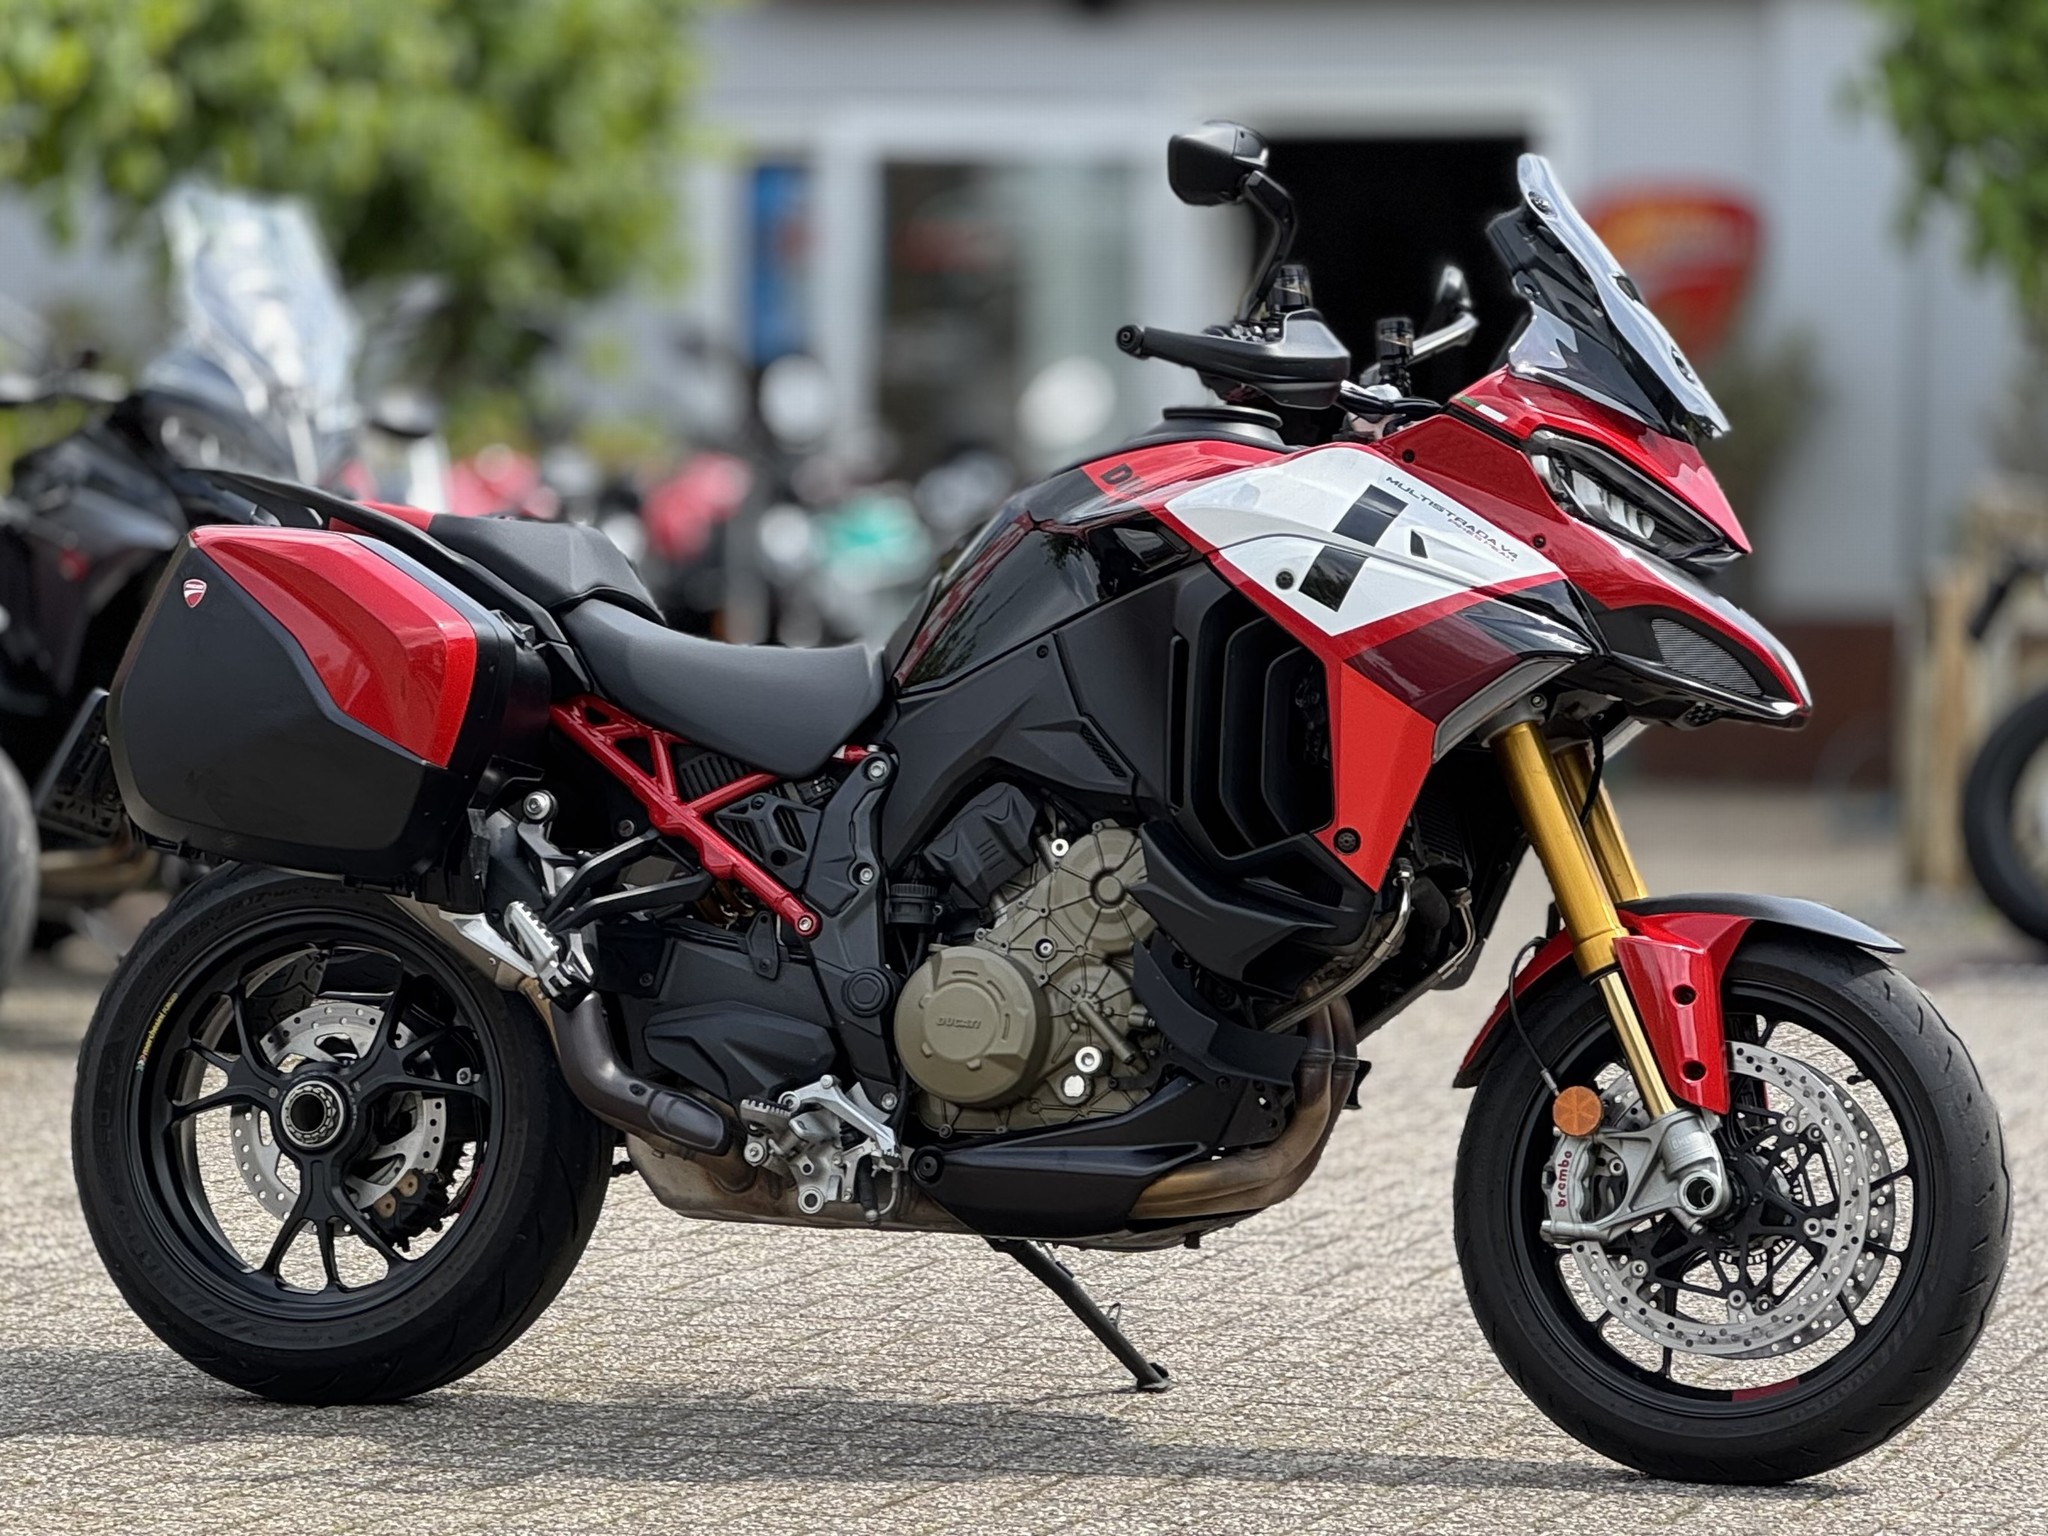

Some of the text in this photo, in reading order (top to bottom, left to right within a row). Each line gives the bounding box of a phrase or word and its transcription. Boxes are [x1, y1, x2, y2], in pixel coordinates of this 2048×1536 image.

[1386, 477, 1518, 559] MULTISTRADA V4
[936, 1017, 982, 1030] DUCATI
[1555, 1150, 1573, 1208] brembo
